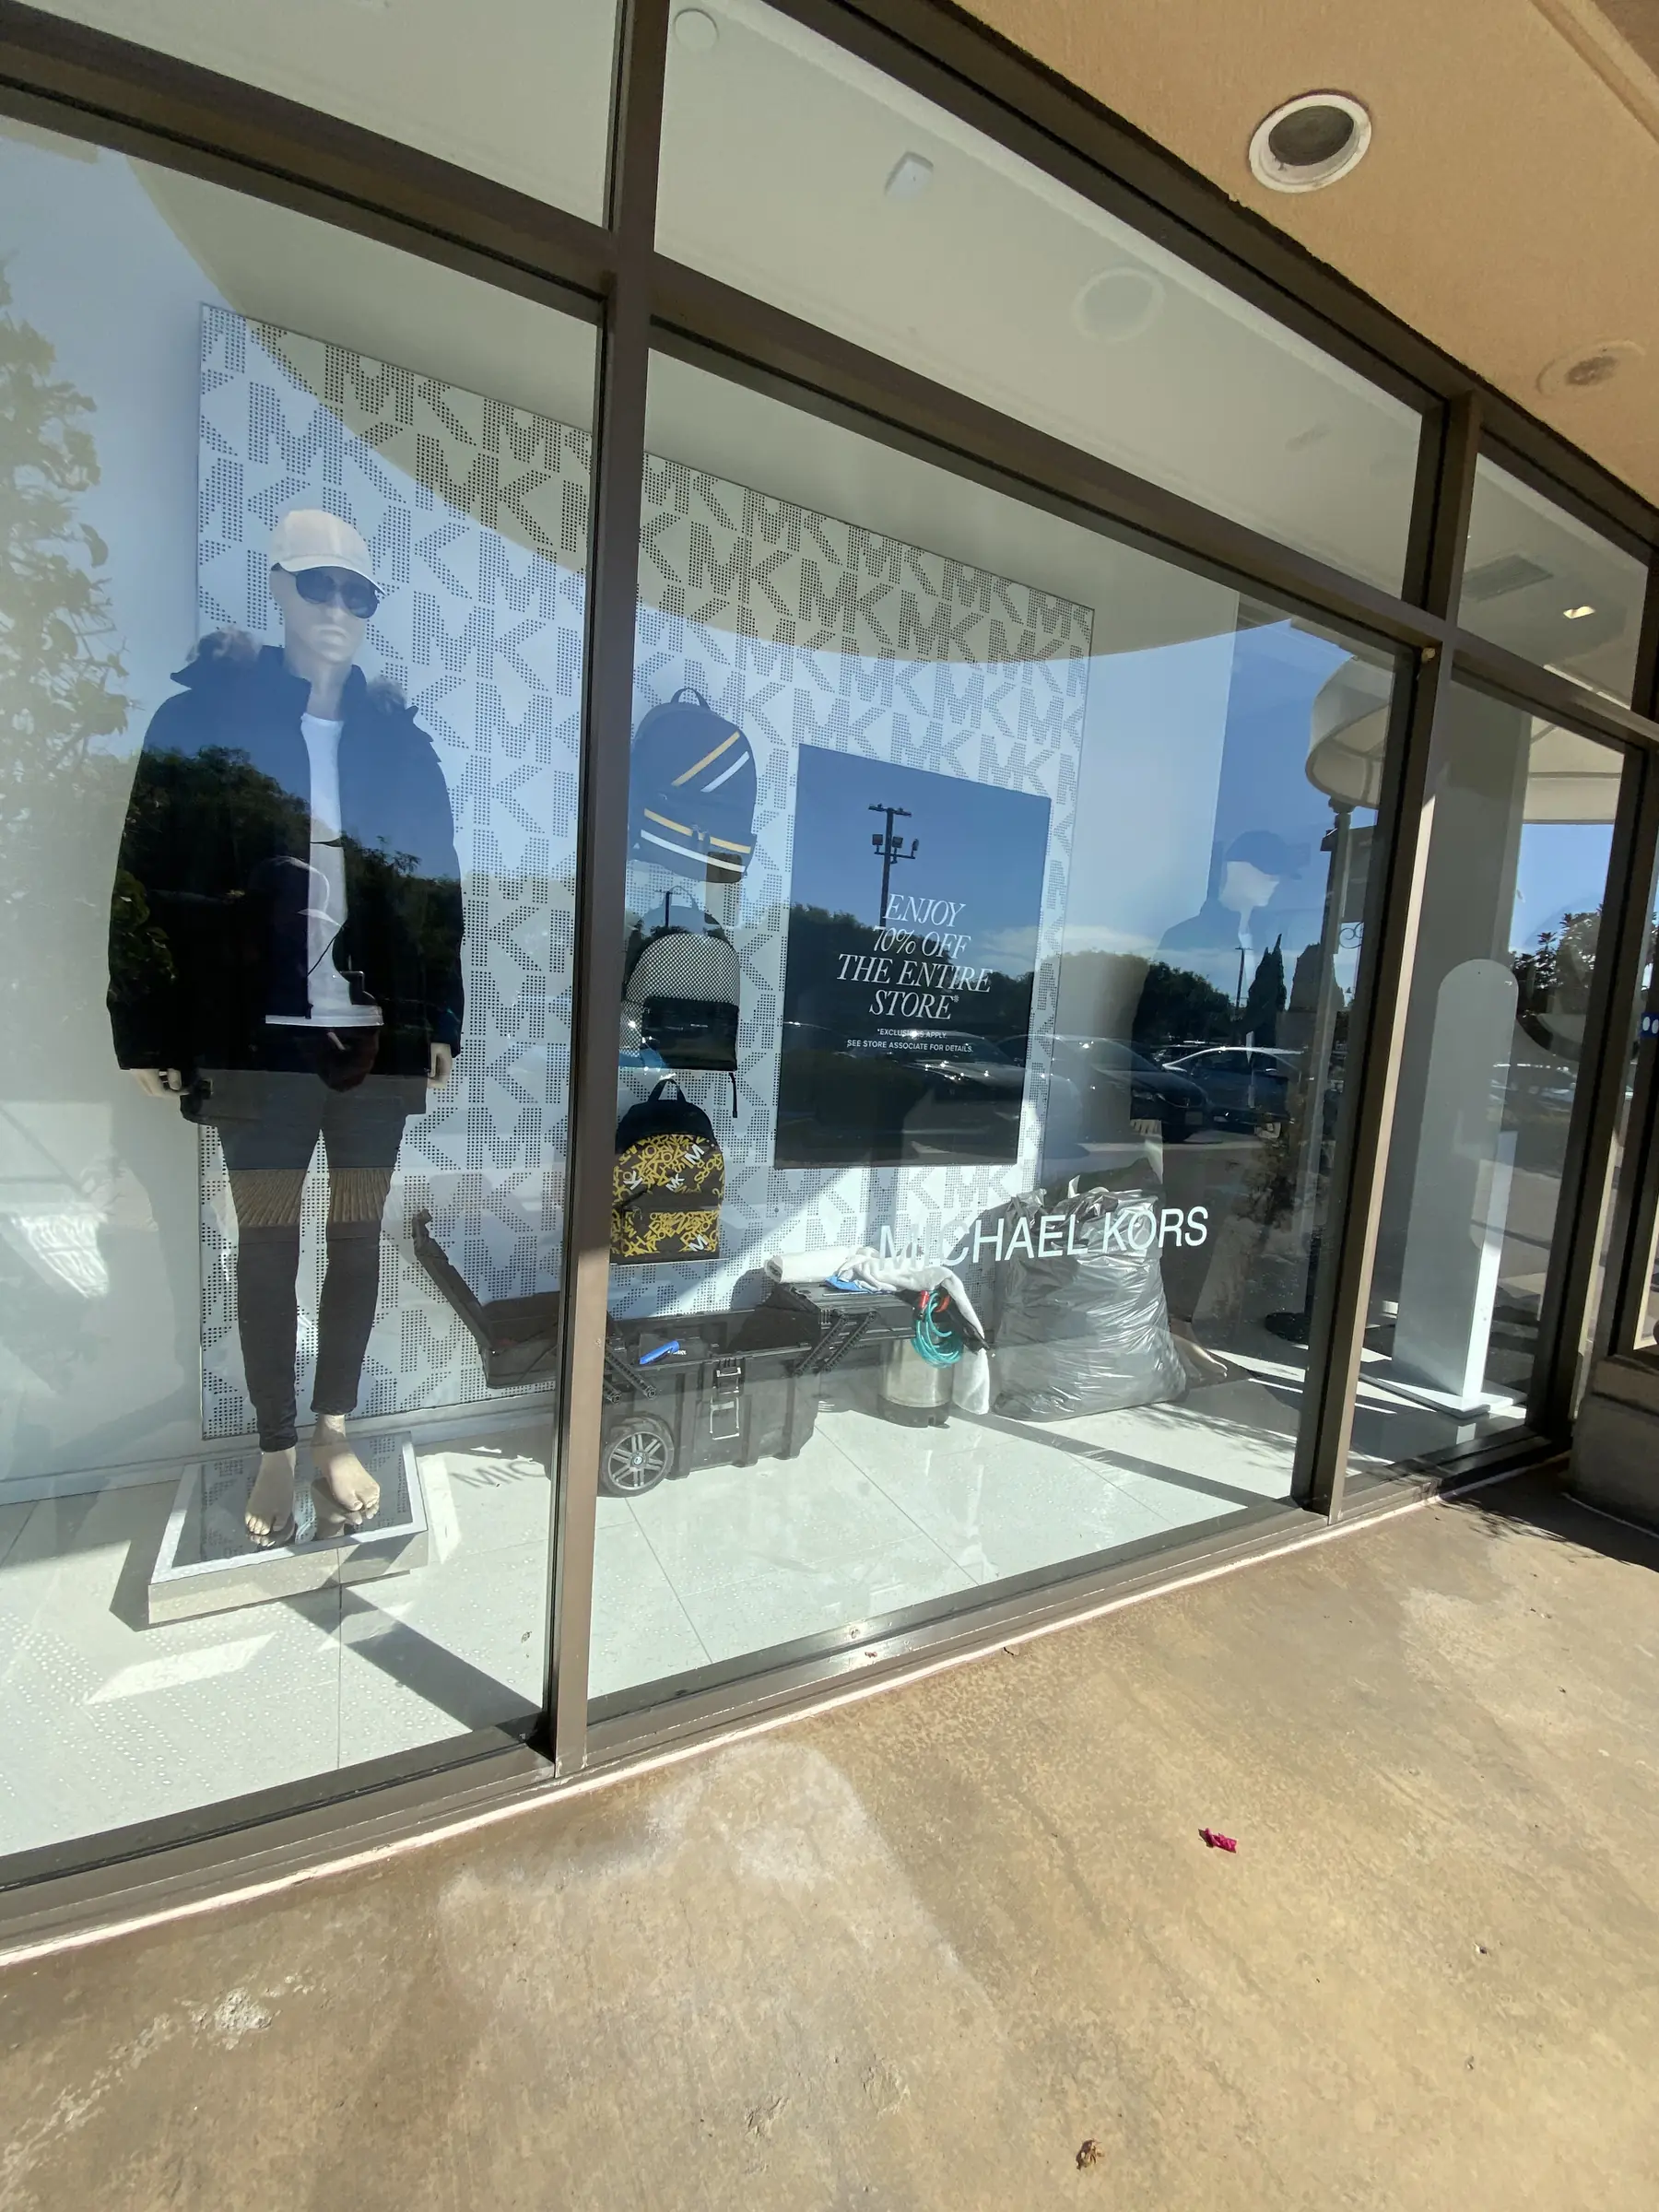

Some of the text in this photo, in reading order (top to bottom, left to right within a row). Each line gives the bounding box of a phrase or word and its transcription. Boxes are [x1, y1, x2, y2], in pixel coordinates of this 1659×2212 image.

[882, 892, 967, 928] ENJOY
[871, 924, 972, 959] 70% OFF
[836, 953, 994, 994] THE ENTIRE
[847, 1039, 862, 1048] SEE
[863, 1040, 888, 1049] STORE
[888, 1041, 928, 1051] ASSOCIATE
[929, 1042, 944, 1052] FOR
[879, 1206, 1209, 1271] MICHAEL KORS
